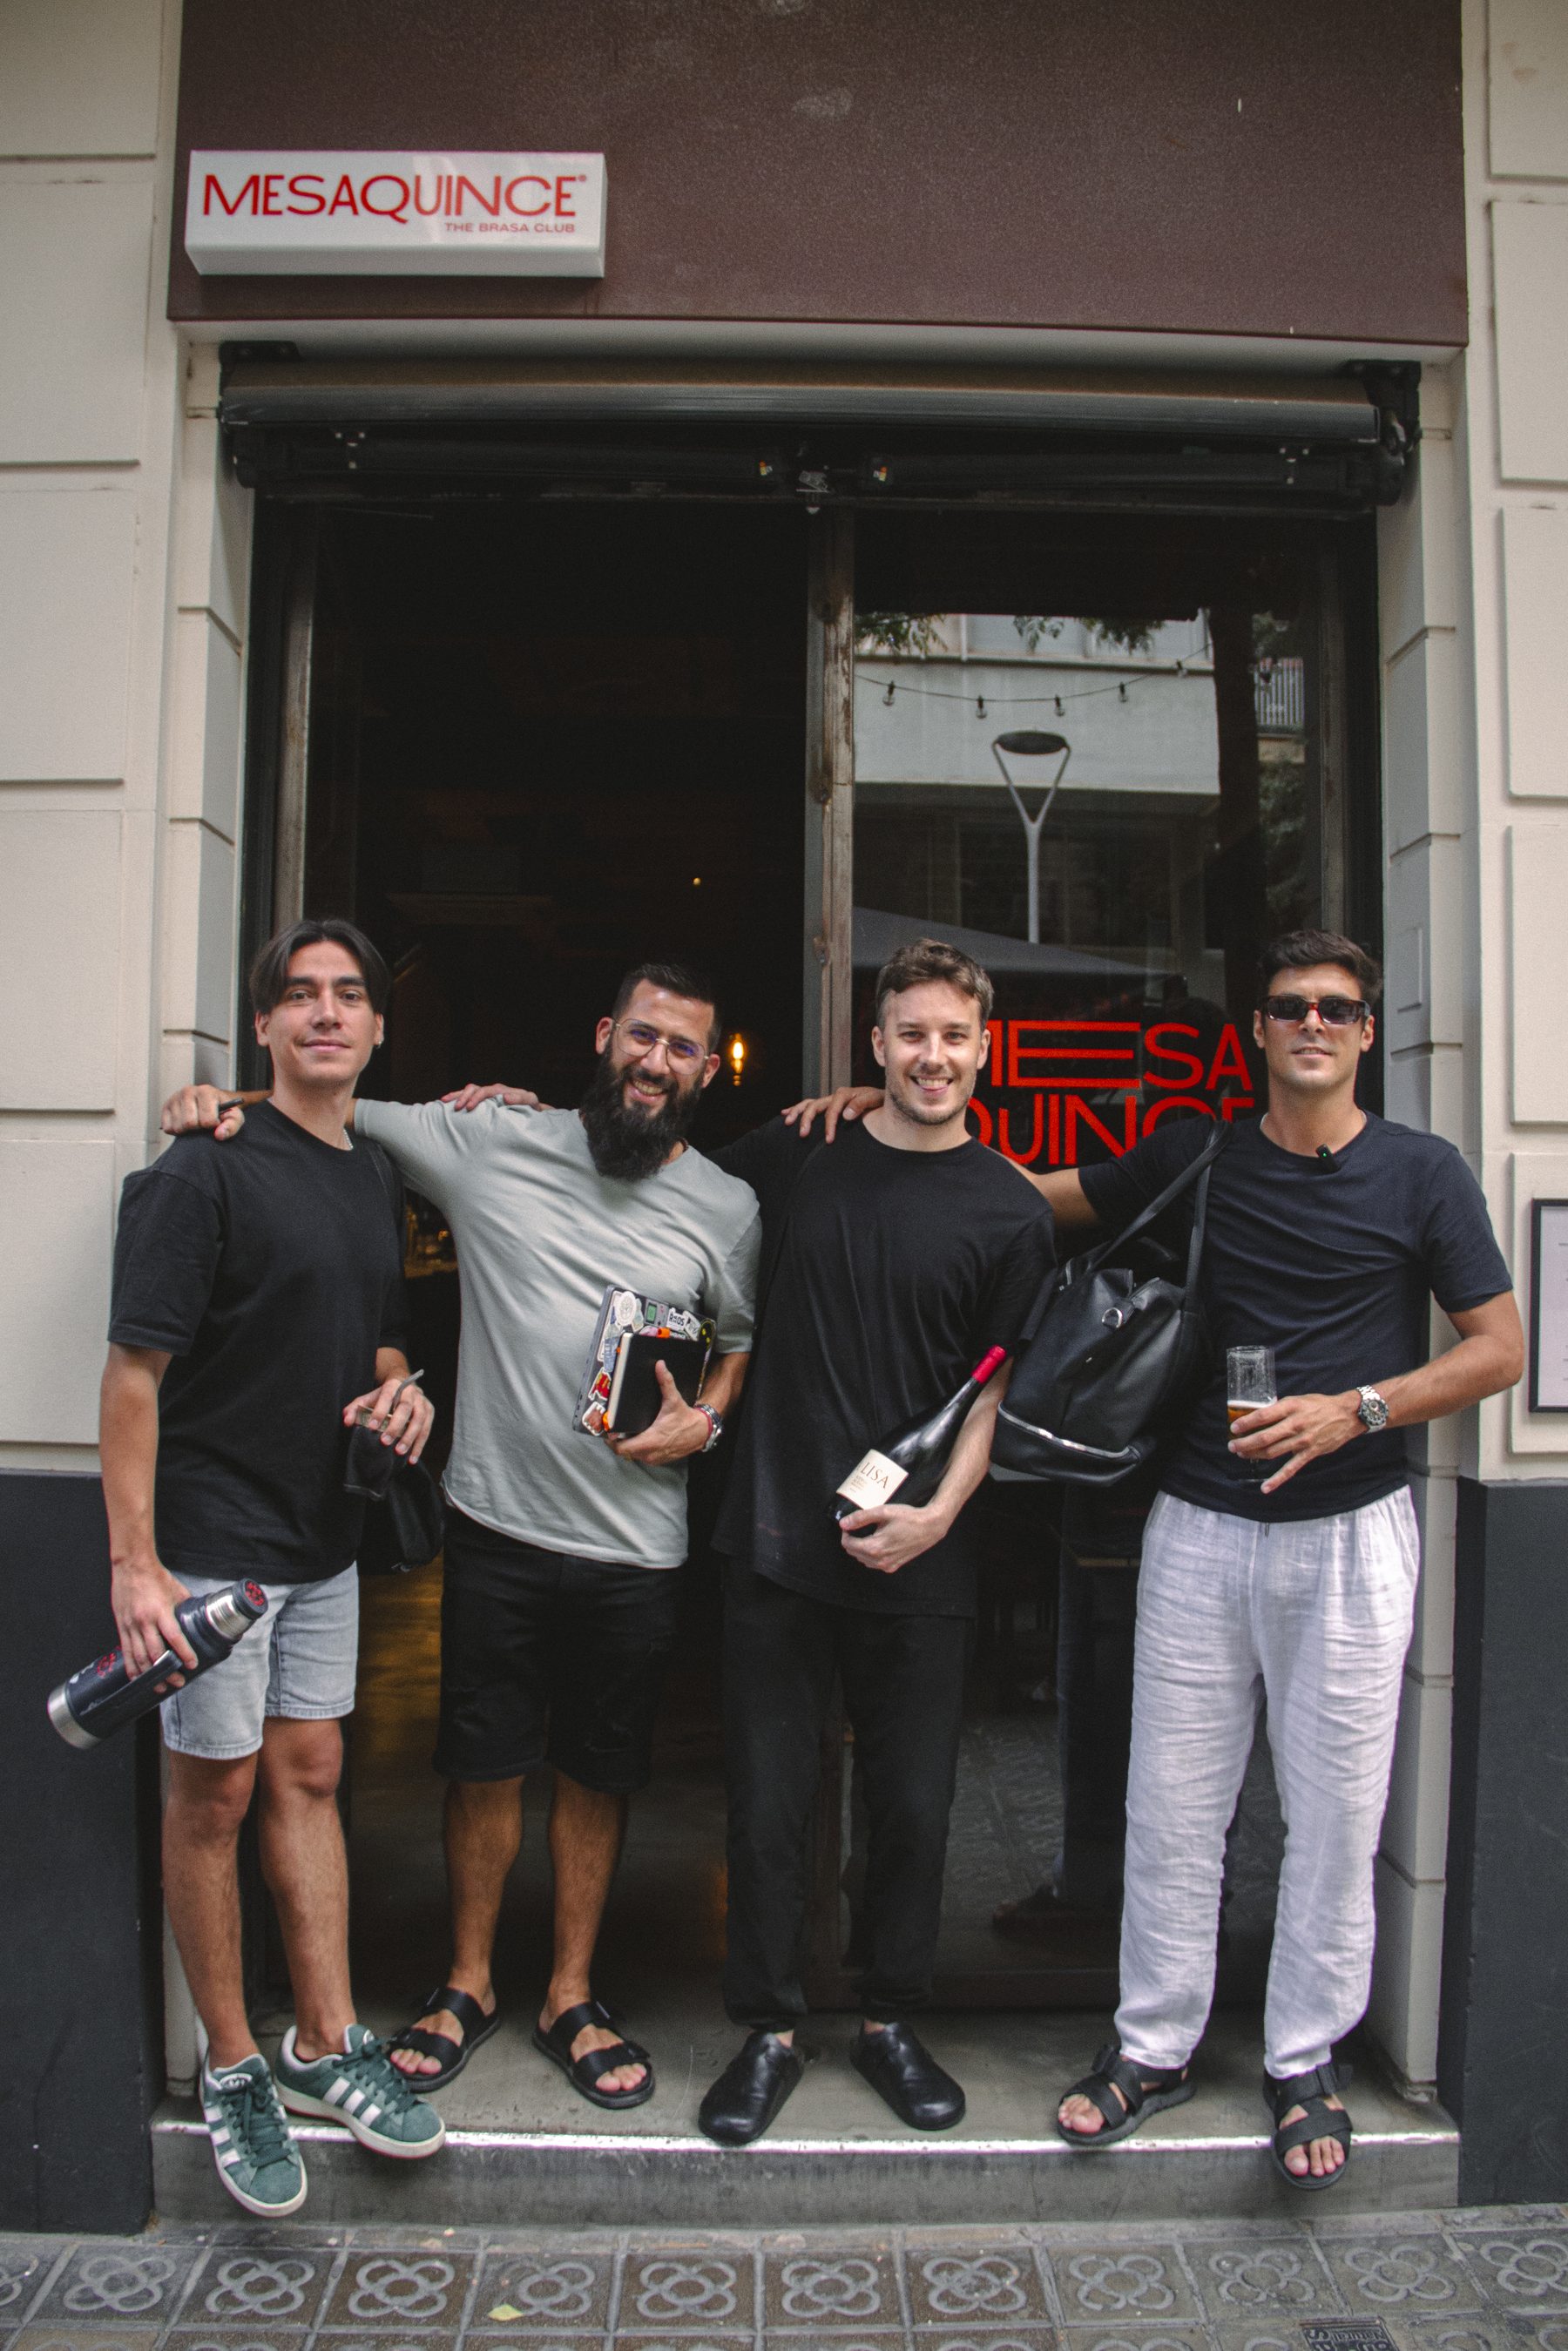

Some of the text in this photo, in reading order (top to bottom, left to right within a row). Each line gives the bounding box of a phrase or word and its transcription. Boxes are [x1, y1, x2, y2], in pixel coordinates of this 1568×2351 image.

[202, 174, 577, 224] MESAQUINCE
[444, 222, 576, 233] THE BRASA CLUB
[860, 1462, 889, 1489] LISA
